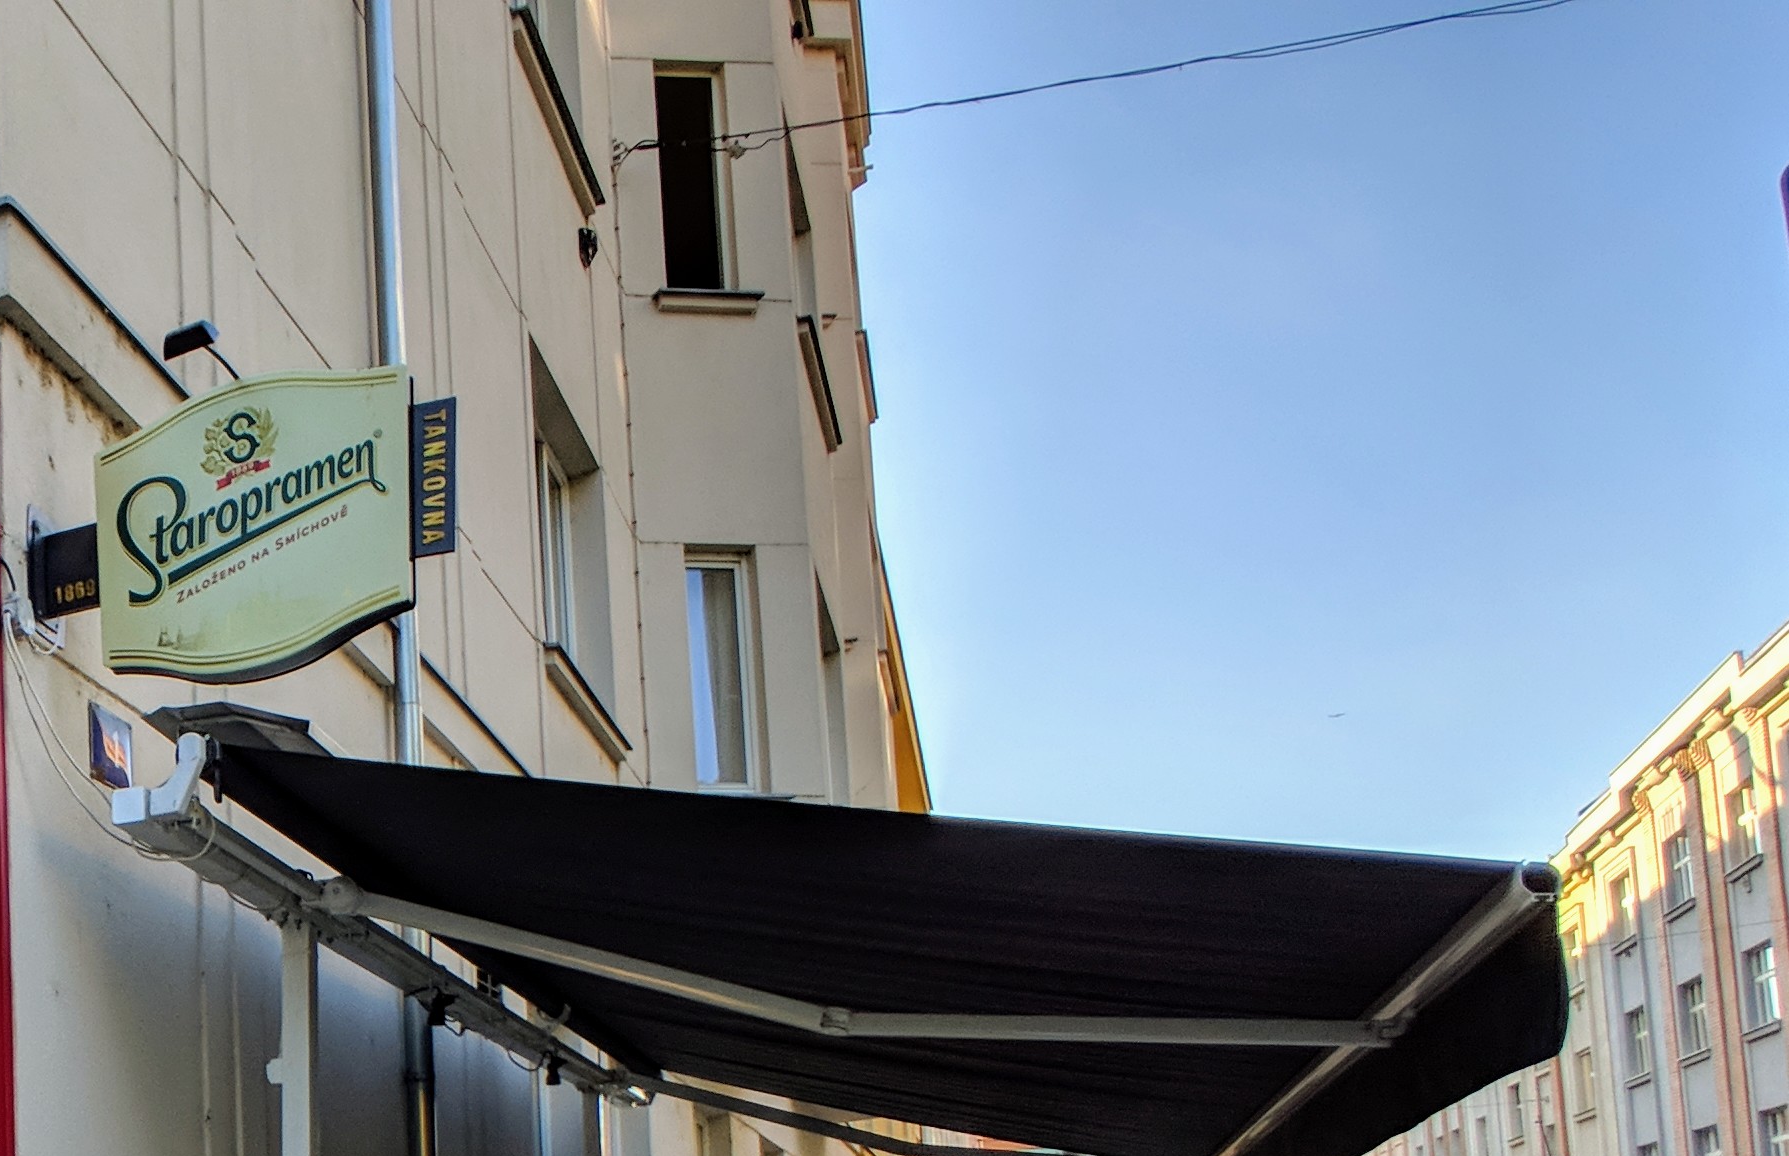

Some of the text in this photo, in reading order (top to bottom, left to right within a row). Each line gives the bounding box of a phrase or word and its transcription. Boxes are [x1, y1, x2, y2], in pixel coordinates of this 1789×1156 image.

[222, 412, 260, 464] S
[422, 409, 447, 545] TANKOVNA
[116, 437, 388, 606] Staropramen
[176, 504, 349, 604] ZALOŽENO NA SMÍCHOVĚ
[55, 579, 96, 604] 1869
